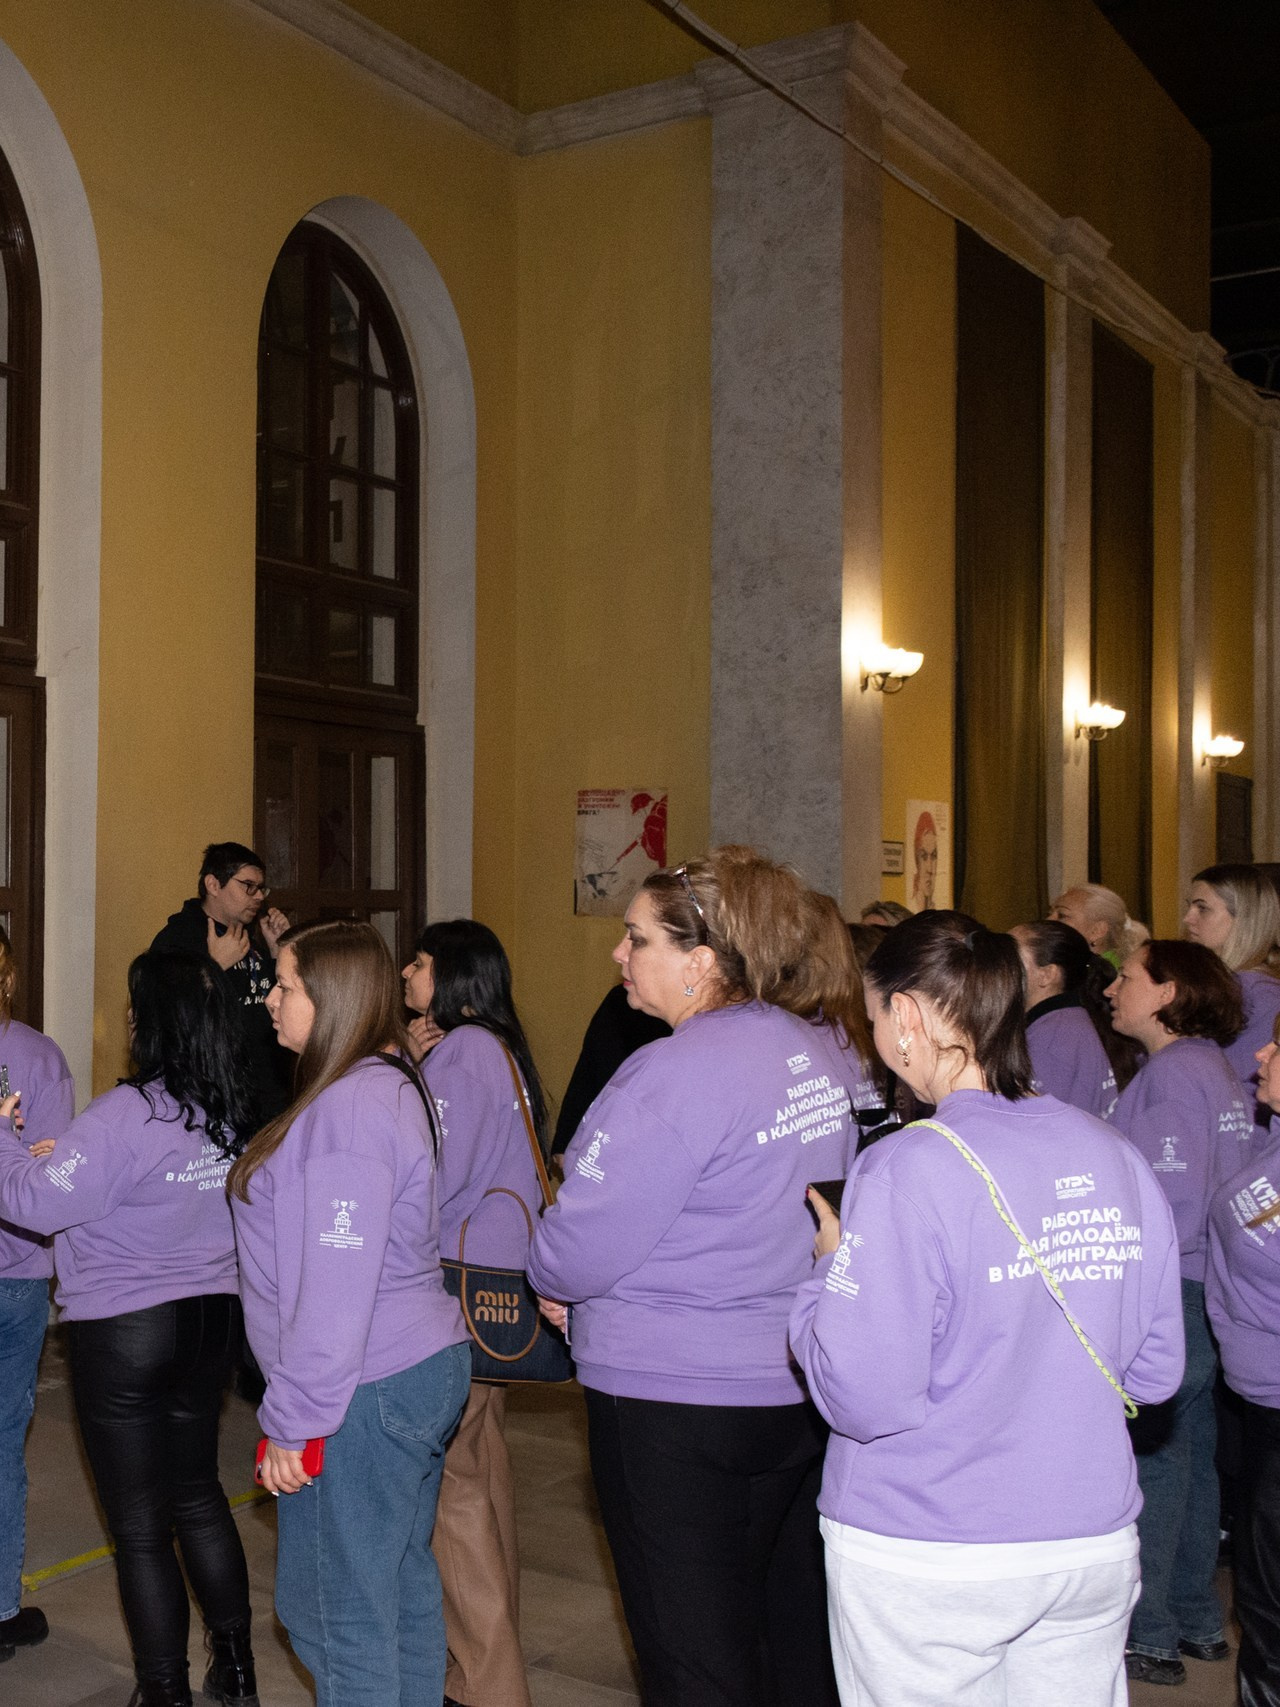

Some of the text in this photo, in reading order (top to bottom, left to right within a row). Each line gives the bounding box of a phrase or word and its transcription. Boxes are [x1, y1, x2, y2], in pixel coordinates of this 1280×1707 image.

[786, 1075, 830, 1100] РАБОТАЮ
[776, 1086, 845, 1123] ДЛЯ МОЛОДЁЖИ
[756, 1131, 768, 1144] В
[800, 1119, 842, 1144] ОБЛАСТИ
[186, 1158, 204, 1171] ДЛЯ
[165, 1172, 175, 1181] В
[198, 1177, 227, 1190] ОБЛАС
[1042, 1207, 1121, 1232] РАБОТАЮ
[1052, 1223, 1141, 1249] МОЛОДЁЖИ
[989, 1267, 1003, 1283] В
[1050, 1264, 1123, 1283] БЛАСТИ
